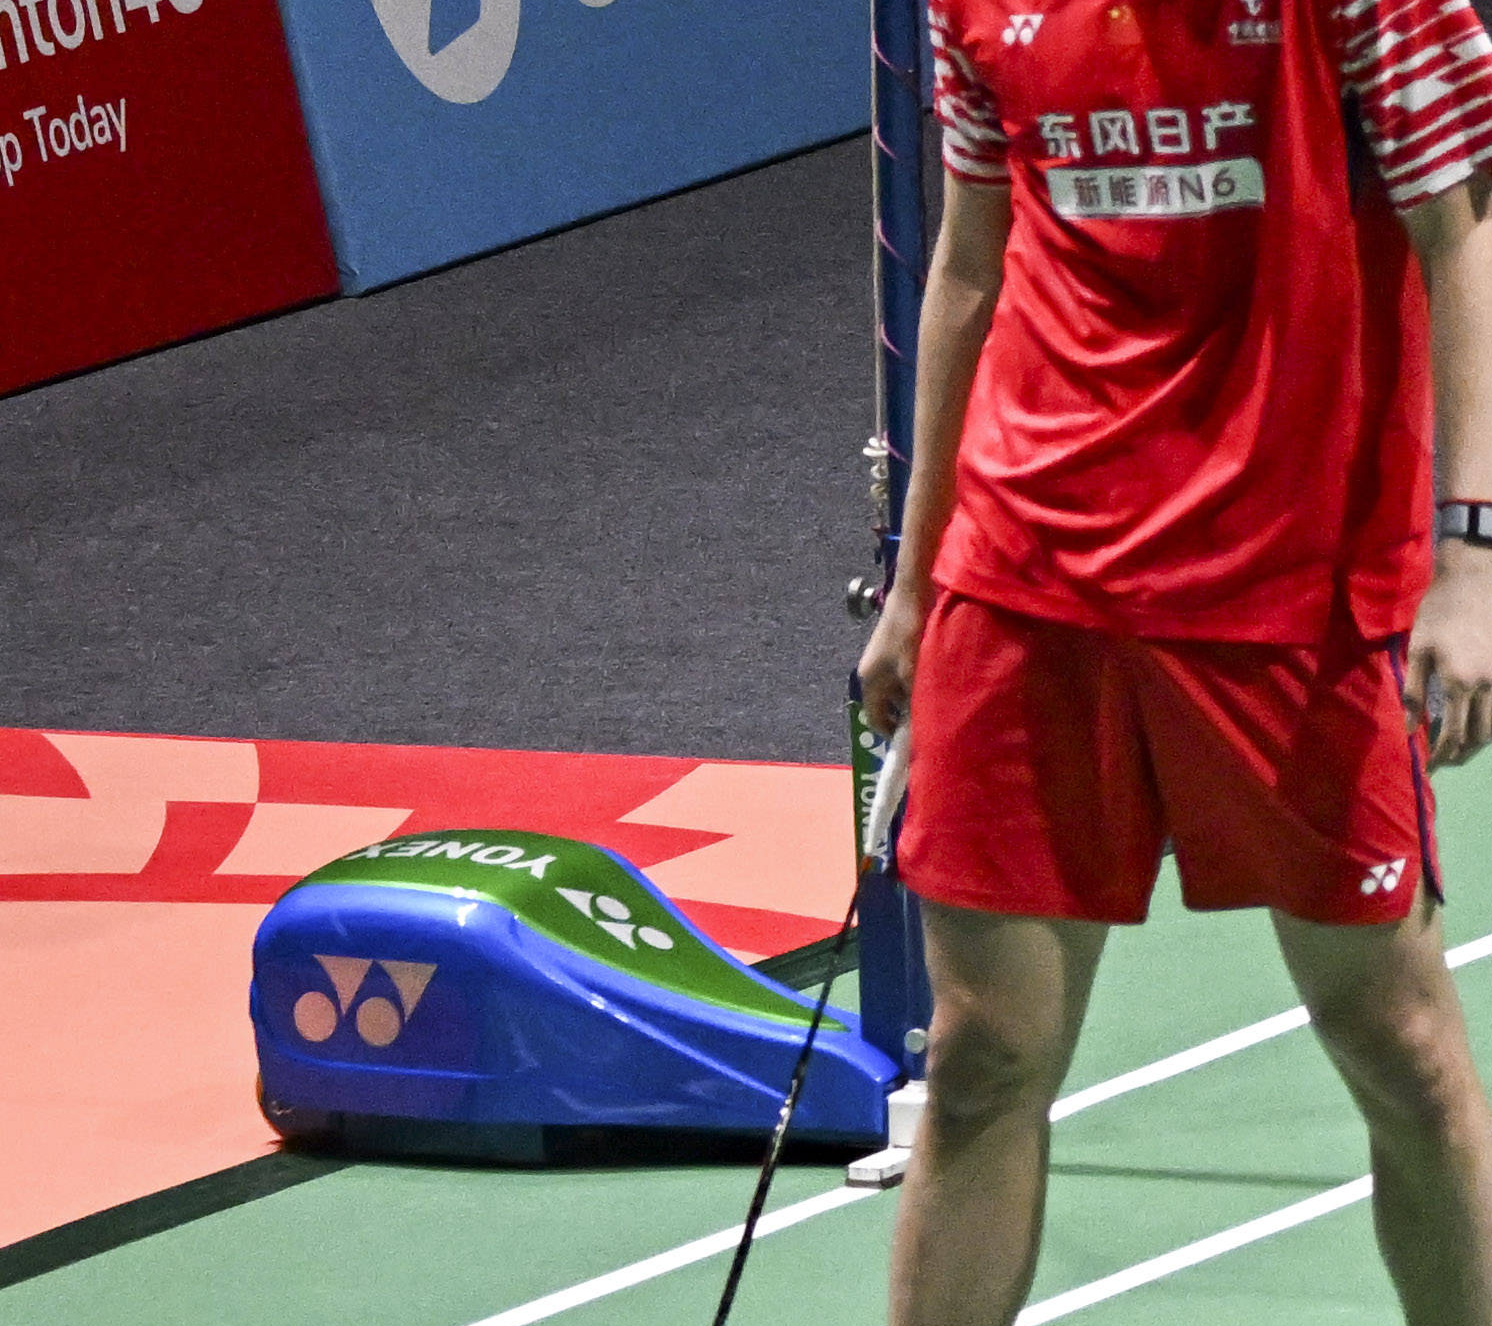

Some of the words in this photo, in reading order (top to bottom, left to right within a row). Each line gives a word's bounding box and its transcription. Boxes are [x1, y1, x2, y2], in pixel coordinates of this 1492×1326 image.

[23, 94, 126, 163] Today
[1036, 100, 1255, 158] 东风日产
[342, 840, 558, 880] YONEX
